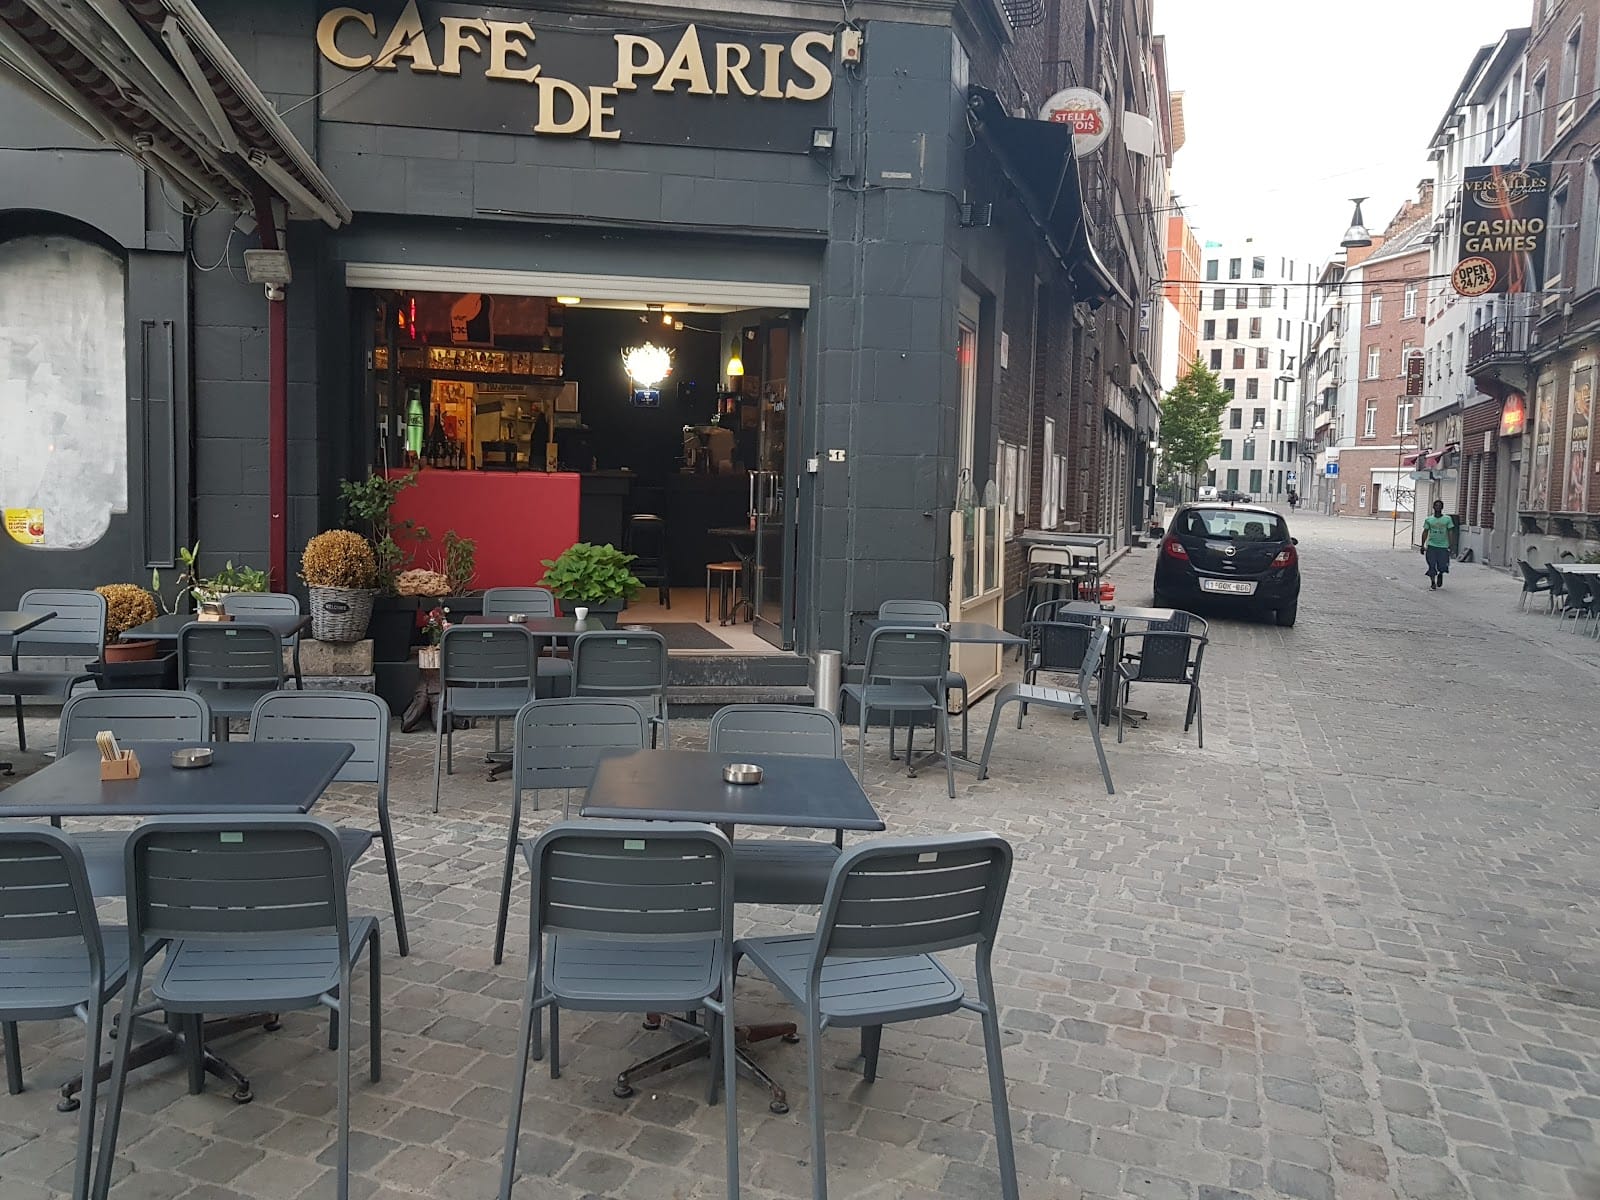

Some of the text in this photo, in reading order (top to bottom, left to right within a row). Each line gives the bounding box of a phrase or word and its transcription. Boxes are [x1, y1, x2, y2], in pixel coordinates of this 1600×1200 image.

[316, 0, 834, 139] CAFE DE PARIS
[1055, 112, 1095, 121] STELLA
[1464, 177, 1547, 192] VERSAILLES
[1462, 218, 1544, 236] CASINO
[1465, 236, 1537, 252] GAMES
[1459, 264, 1487, 279] OPEN
[1461, 274, 1490, 289] 24/24
